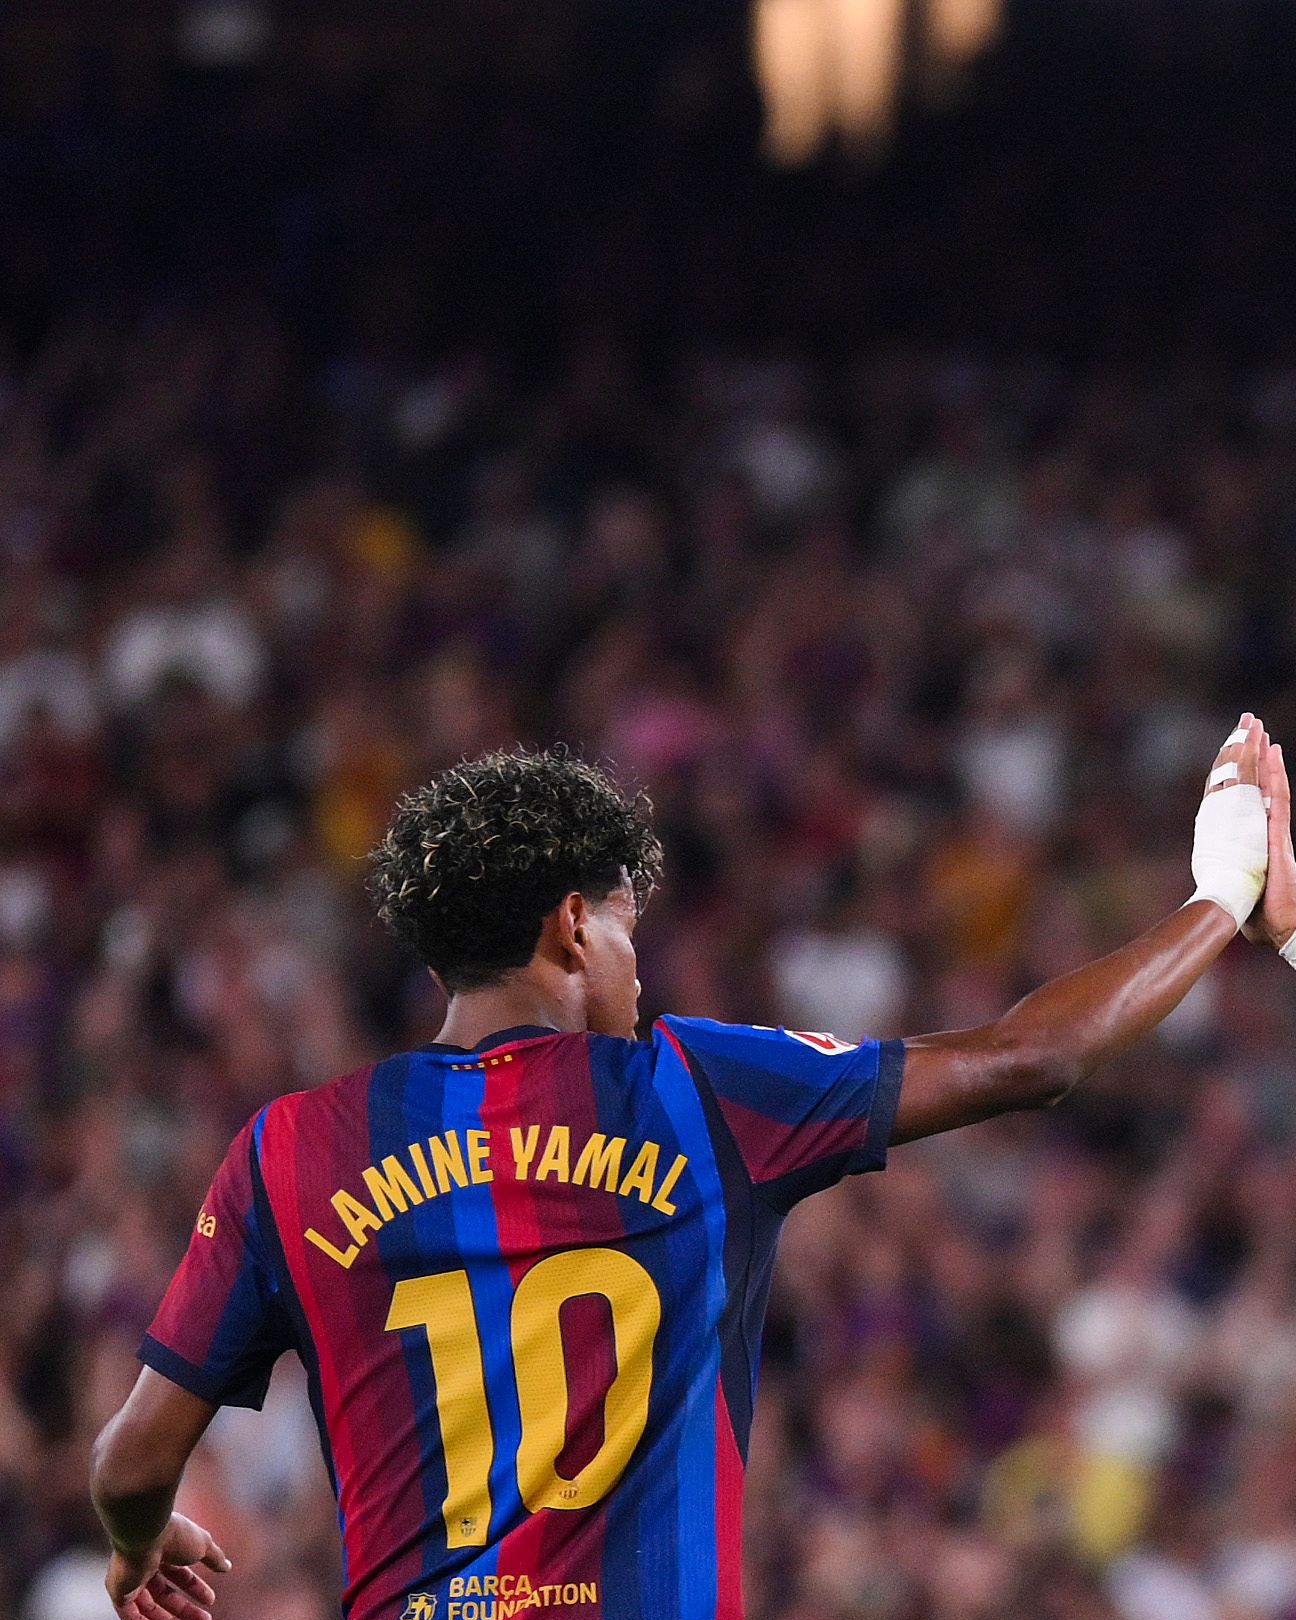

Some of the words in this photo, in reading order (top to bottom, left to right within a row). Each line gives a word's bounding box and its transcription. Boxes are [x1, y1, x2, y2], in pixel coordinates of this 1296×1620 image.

[304, 1129, 495, 1270] LAMINE
[511, 1124, 690, 1216] YAMAL
[383, 1246, 662, 1550] 10
[449, 1575, 532, 1600] BARÇA
